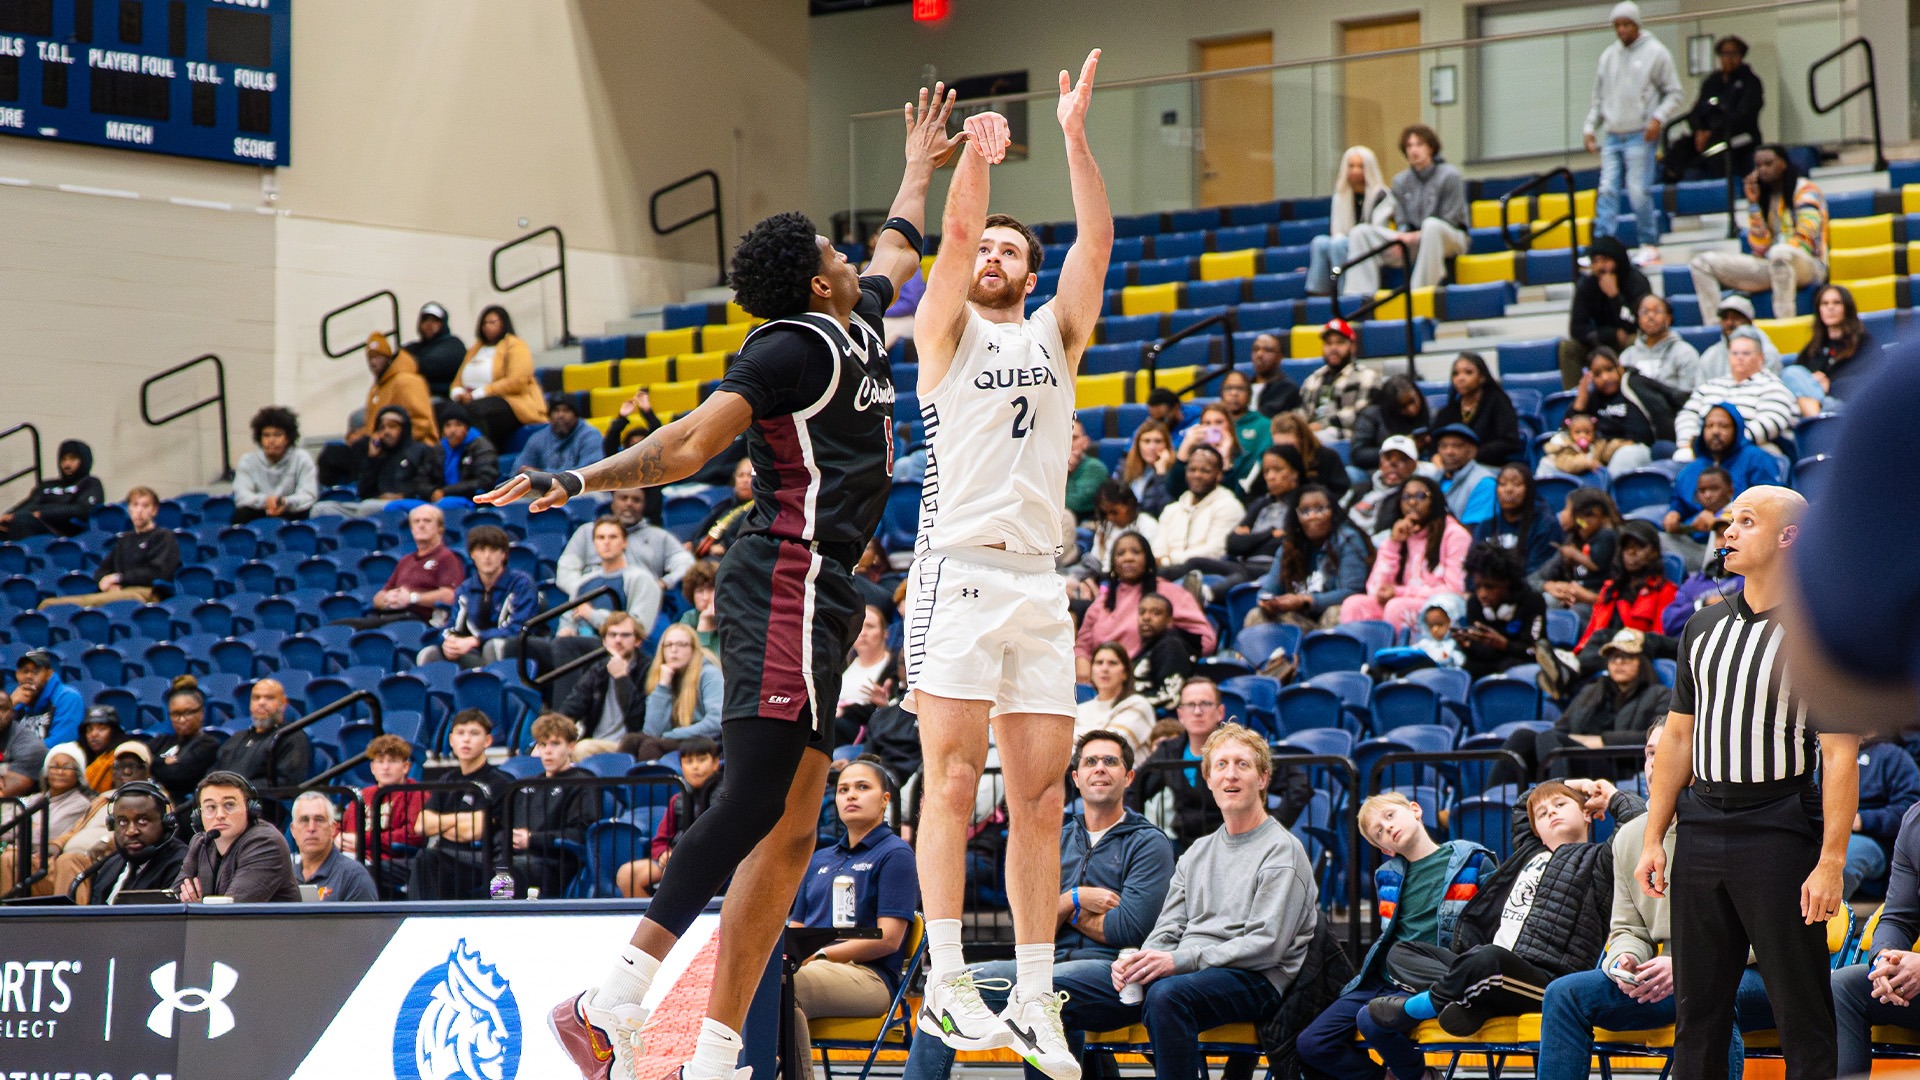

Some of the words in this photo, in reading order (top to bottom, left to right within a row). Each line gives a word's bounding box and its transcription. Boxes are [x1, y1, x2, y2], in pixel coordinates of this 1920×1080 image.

[88, 48, 139, 73] PLAYER
[141, 55, 176, 78] FOUL
[234, 68, 277, 92] FOULS
[106, 120, 154, 144] MATCH
[234, 137, 277, 160] SCORE
[1010, 395, 1037, 439] 2
[768, 695, 791, 704] EKU
